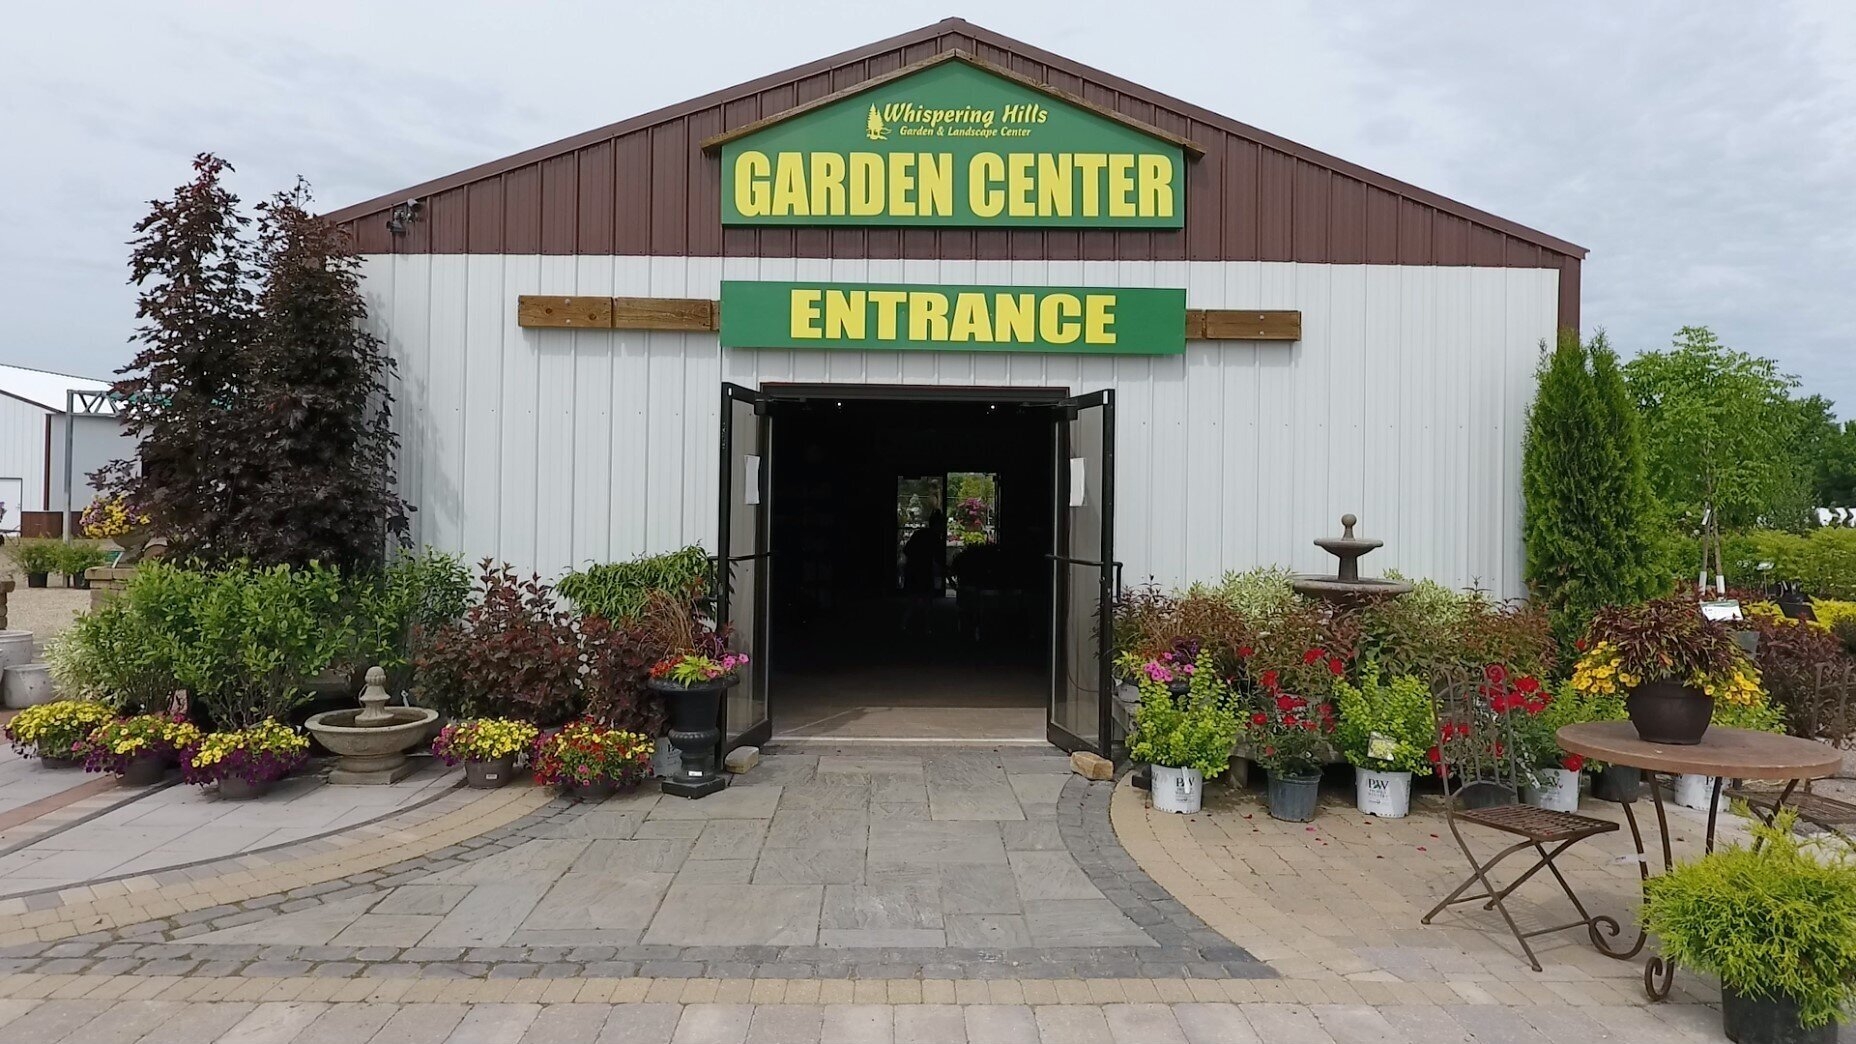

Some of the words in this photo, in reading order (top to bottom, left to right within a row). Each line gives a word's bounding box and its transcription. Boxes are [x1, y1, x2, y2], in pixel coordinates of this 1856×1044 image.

[884, 102, 995, 128] Whispering
[1002, 103, 1048, 123] Hills
[900, 125, 933, 136] Garden
[936, 127, 944, 136] &
[948, 126, 998, 138] Landscape
[1001, 126, 1032, 136] Center
[734, 151, 953, 218] GARDEN
[969, 152, 1174, 219] CENTER
[790, 289, 1117, 345] ENTRANCE
